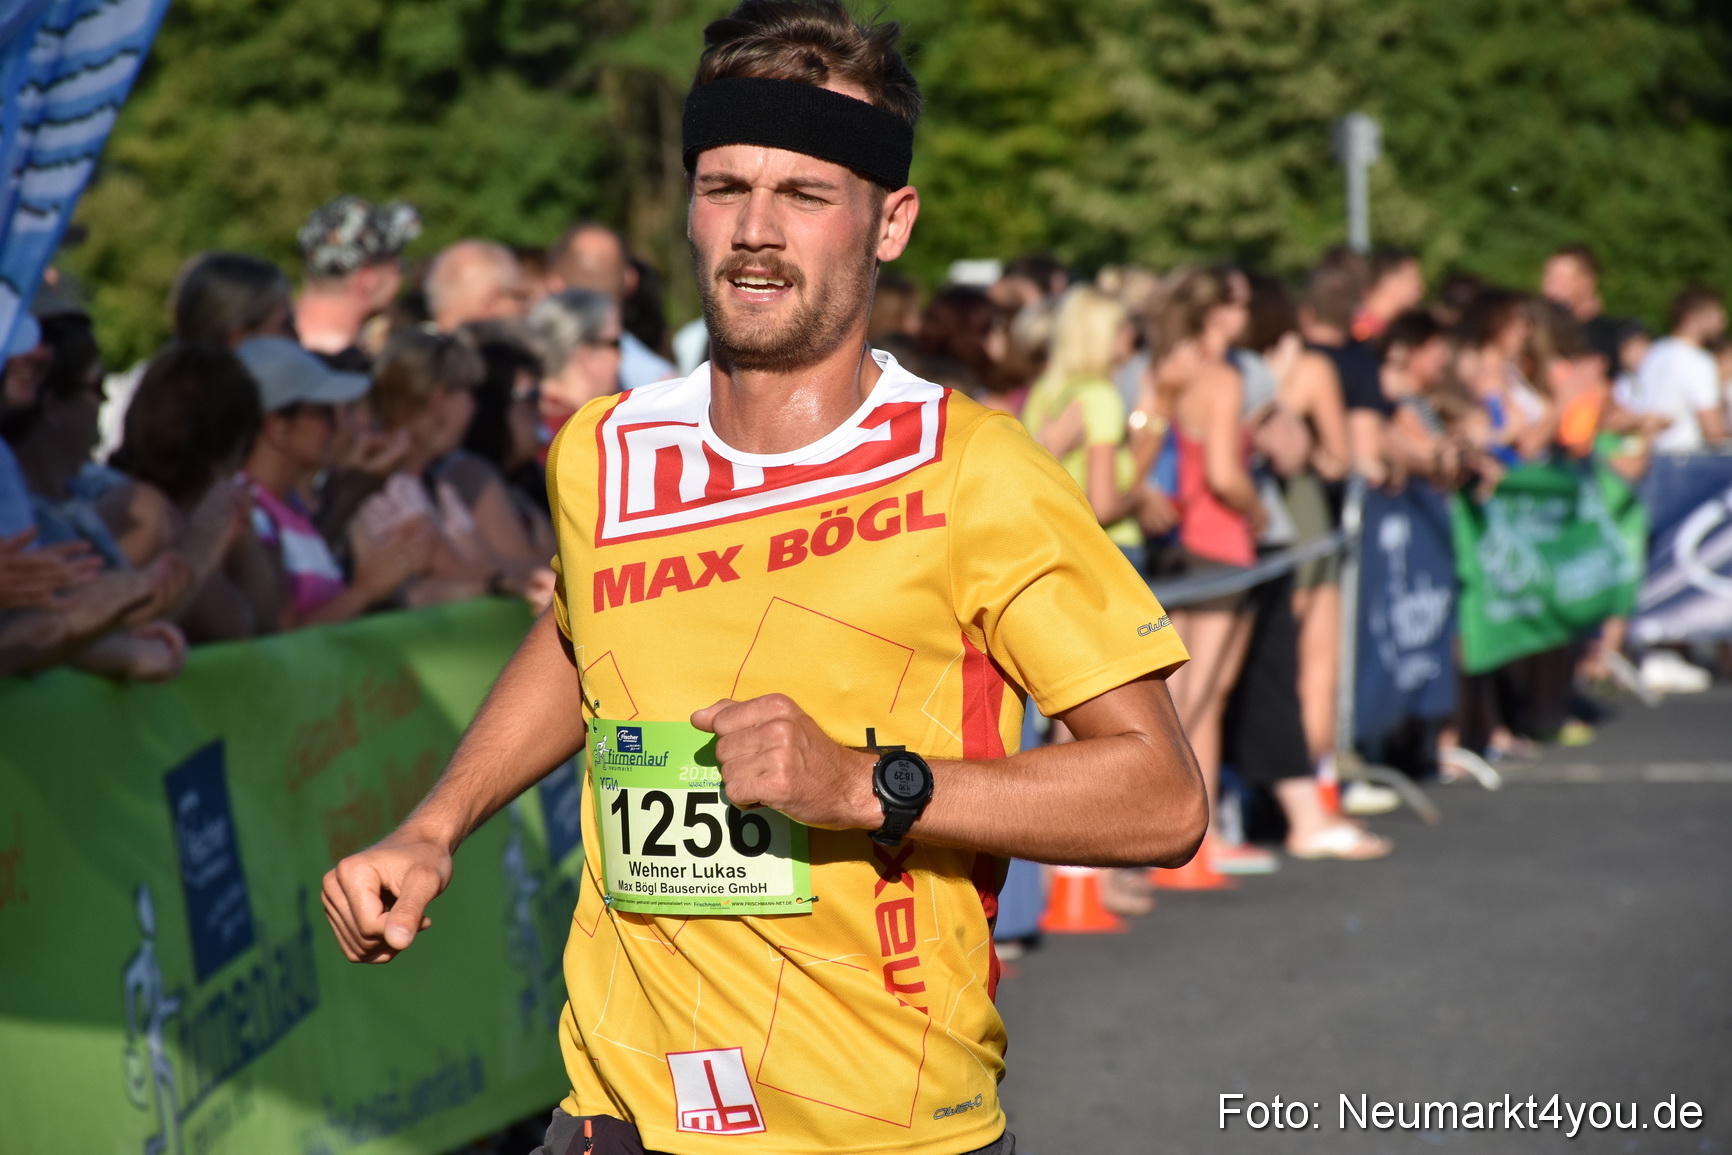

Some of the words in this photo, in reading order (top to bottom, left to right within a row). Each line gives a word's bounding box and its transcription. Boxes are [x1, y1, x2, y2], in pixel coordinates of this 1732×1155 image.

[593, 544, 744, 614] MAX
[767, 489, 947, 573] BÖGL
[608, 749, 670, 766] firmenlauf
[611, 788, 772, 858] 1256
[629, 861, 686, 878] Wehner
[692, 863, 747, 878] Lukas
[618, 880, 633, 892] Max
[635, 881, 657, 895] Bögl
[660, 883, 725, 894] Bauservice
[728, 883, 767, 893] GmbH
